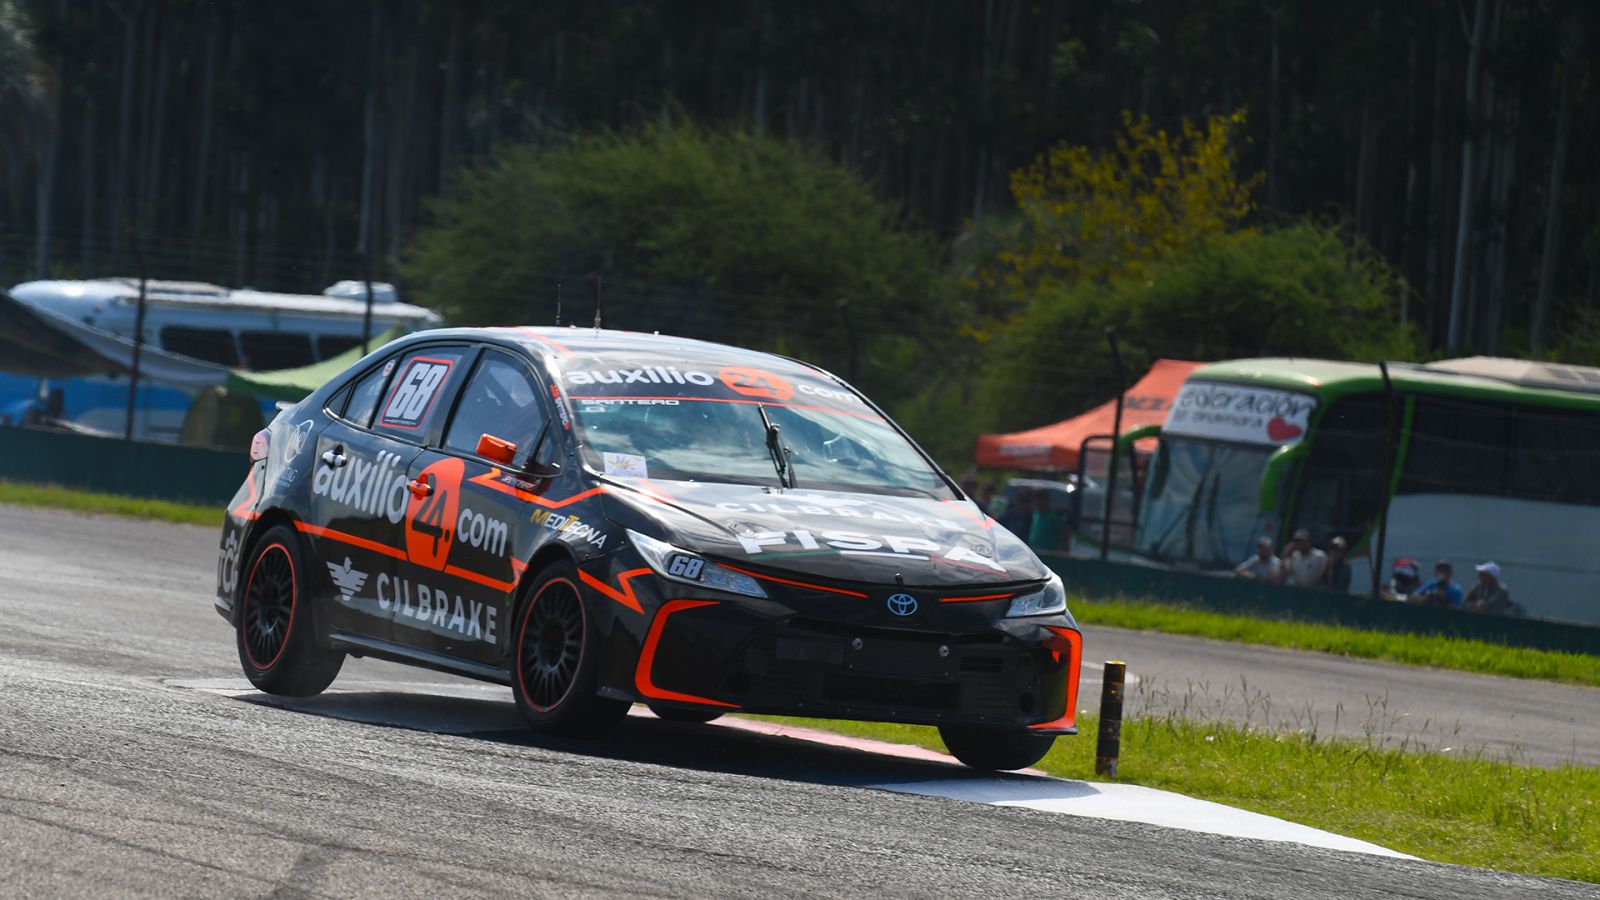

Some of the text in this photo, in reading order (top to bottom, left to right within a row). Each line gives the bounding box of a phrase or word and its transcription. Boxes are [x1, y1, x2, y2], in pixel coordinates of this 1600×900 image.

[385, 362, 449, 420] 68
[669, 555, 705, 579] 68
[736, 530, 1006, 573] FISPA
[376, 572, 497, 645] CILBRAKE
